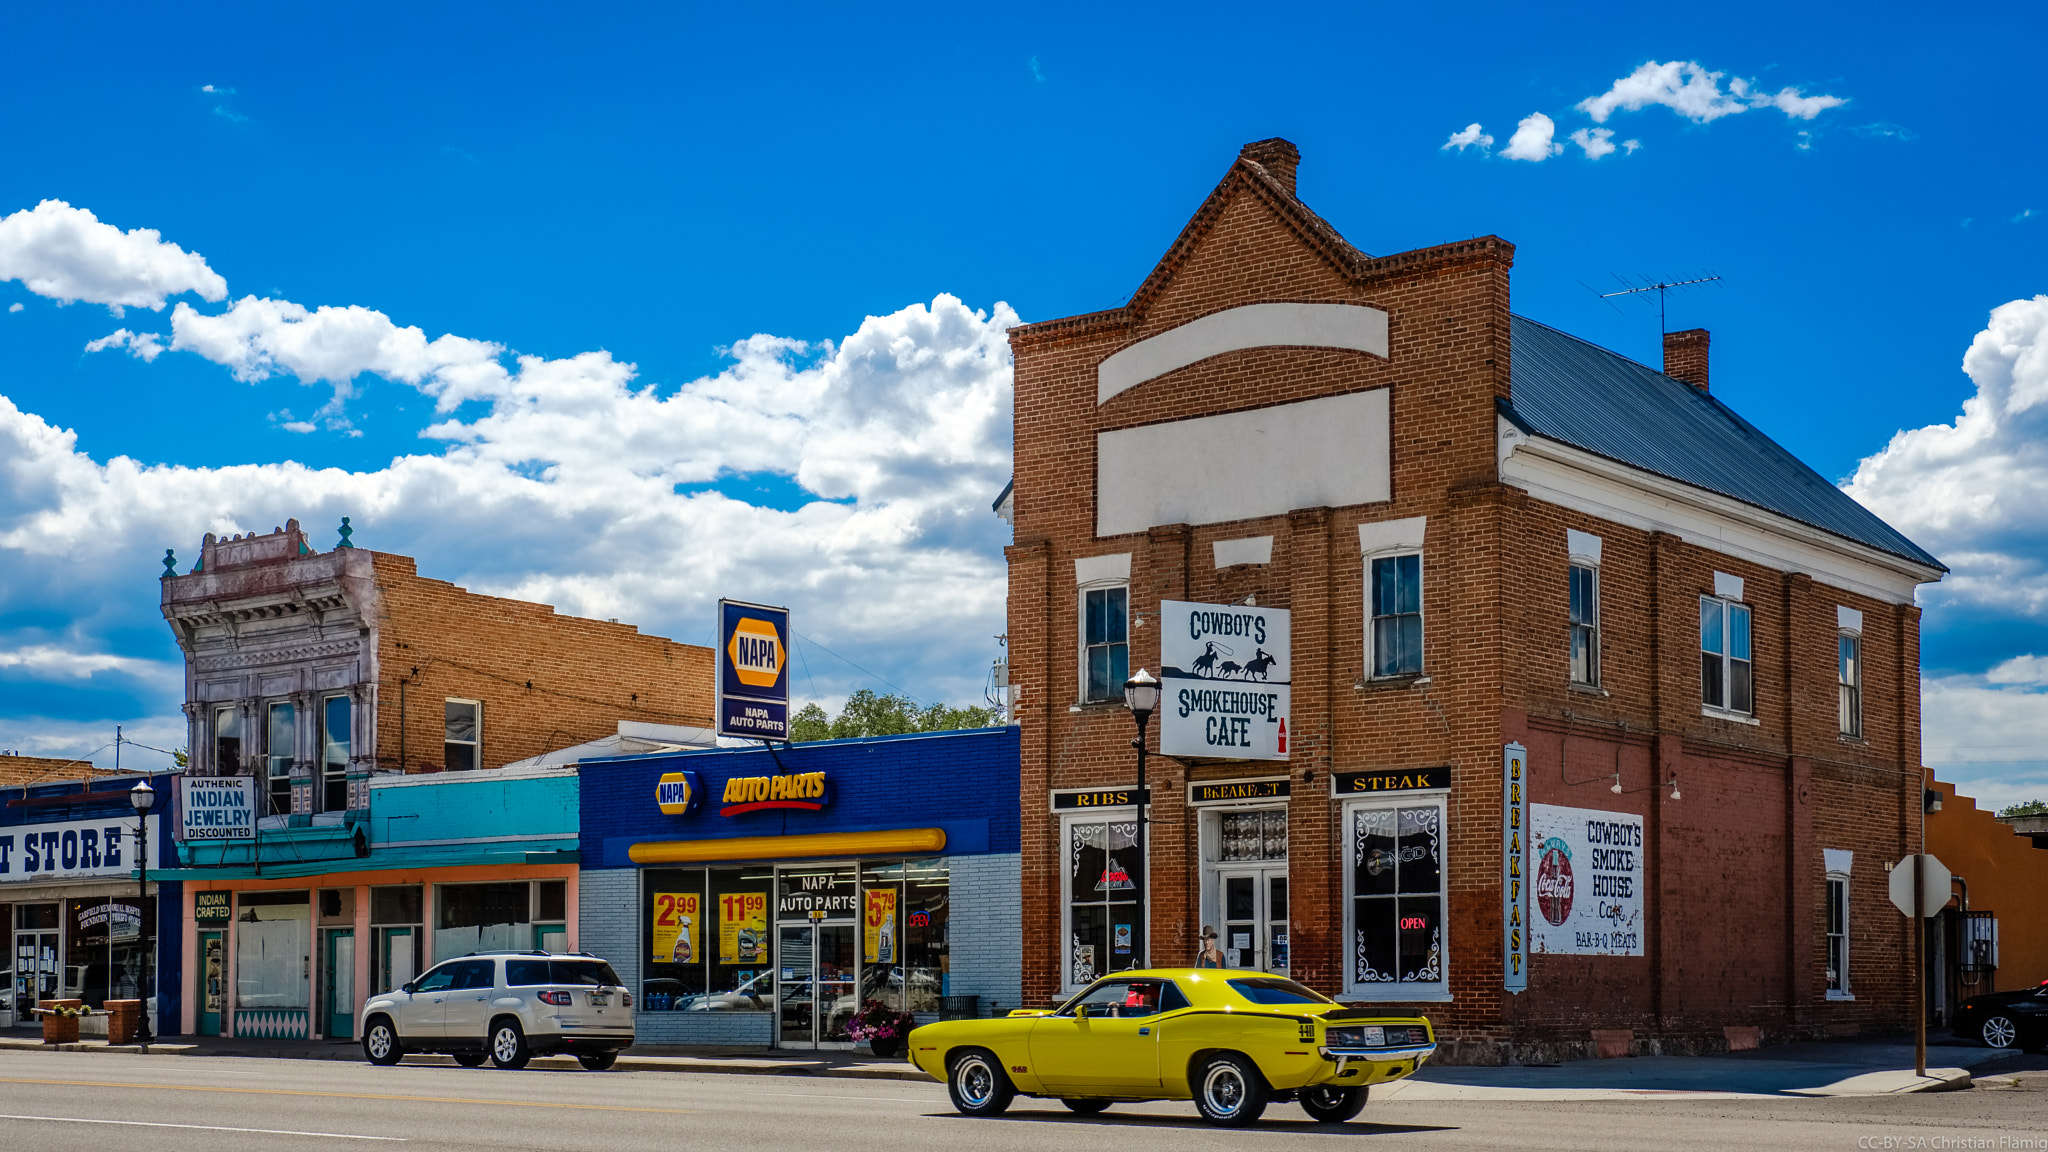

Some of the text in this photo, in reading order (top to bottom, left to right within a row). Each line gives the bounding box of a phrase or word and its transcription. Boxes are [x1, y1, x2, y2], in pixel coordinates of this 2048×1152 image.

[1190, 611, 1266, 644] COWBOY'S
[739, 636, 776, 669] NAPA
[745, 707, 769, 719] NAPA
[1178, 688, 1278, 723] SMOKEHOUSE
[730, 716, 784, 731] AUTO PARTS
[1206, 716, 1251, 747] CAFE
[190, 780, 243, 788] AUTHENIC
[659, 771, 826, 804] NAPA AUTO PARTS
[1353, 774, 1431, 791] STEAK
[190, 791, 245, 807] INDIAN
[1076, 792, 1129, 806] RIBS
[184, 809, 251, 827] JEWELRY
[188, 828, 251, 838] DISCOUNTED
[1587, 820, 1641, 847] COWBOY'S
[24, 826, 122, 872] STORE
[1510, 758, 1522, 976] BREAKFAST
[1592, 848, 1634, 872] SMOKE
[802, 876, 835, 890] NAPA
[1592, 875, 1633, 898] HOUSE
[198, 894, 226, 906] INDIAN
[780, 896, 857, 911] AUTO PARTS
[78, 906, 99, 921] GARFIELD
[196, 906, 230, 918] CRAFTED
[909, 914, 929, 927] OPEN
[1400, 917, 1426, 930] OPEN
[1575, 932, 1637, 950] BAR-B-Q MEATS
[1298, 1025, 1314, 1037] 440
